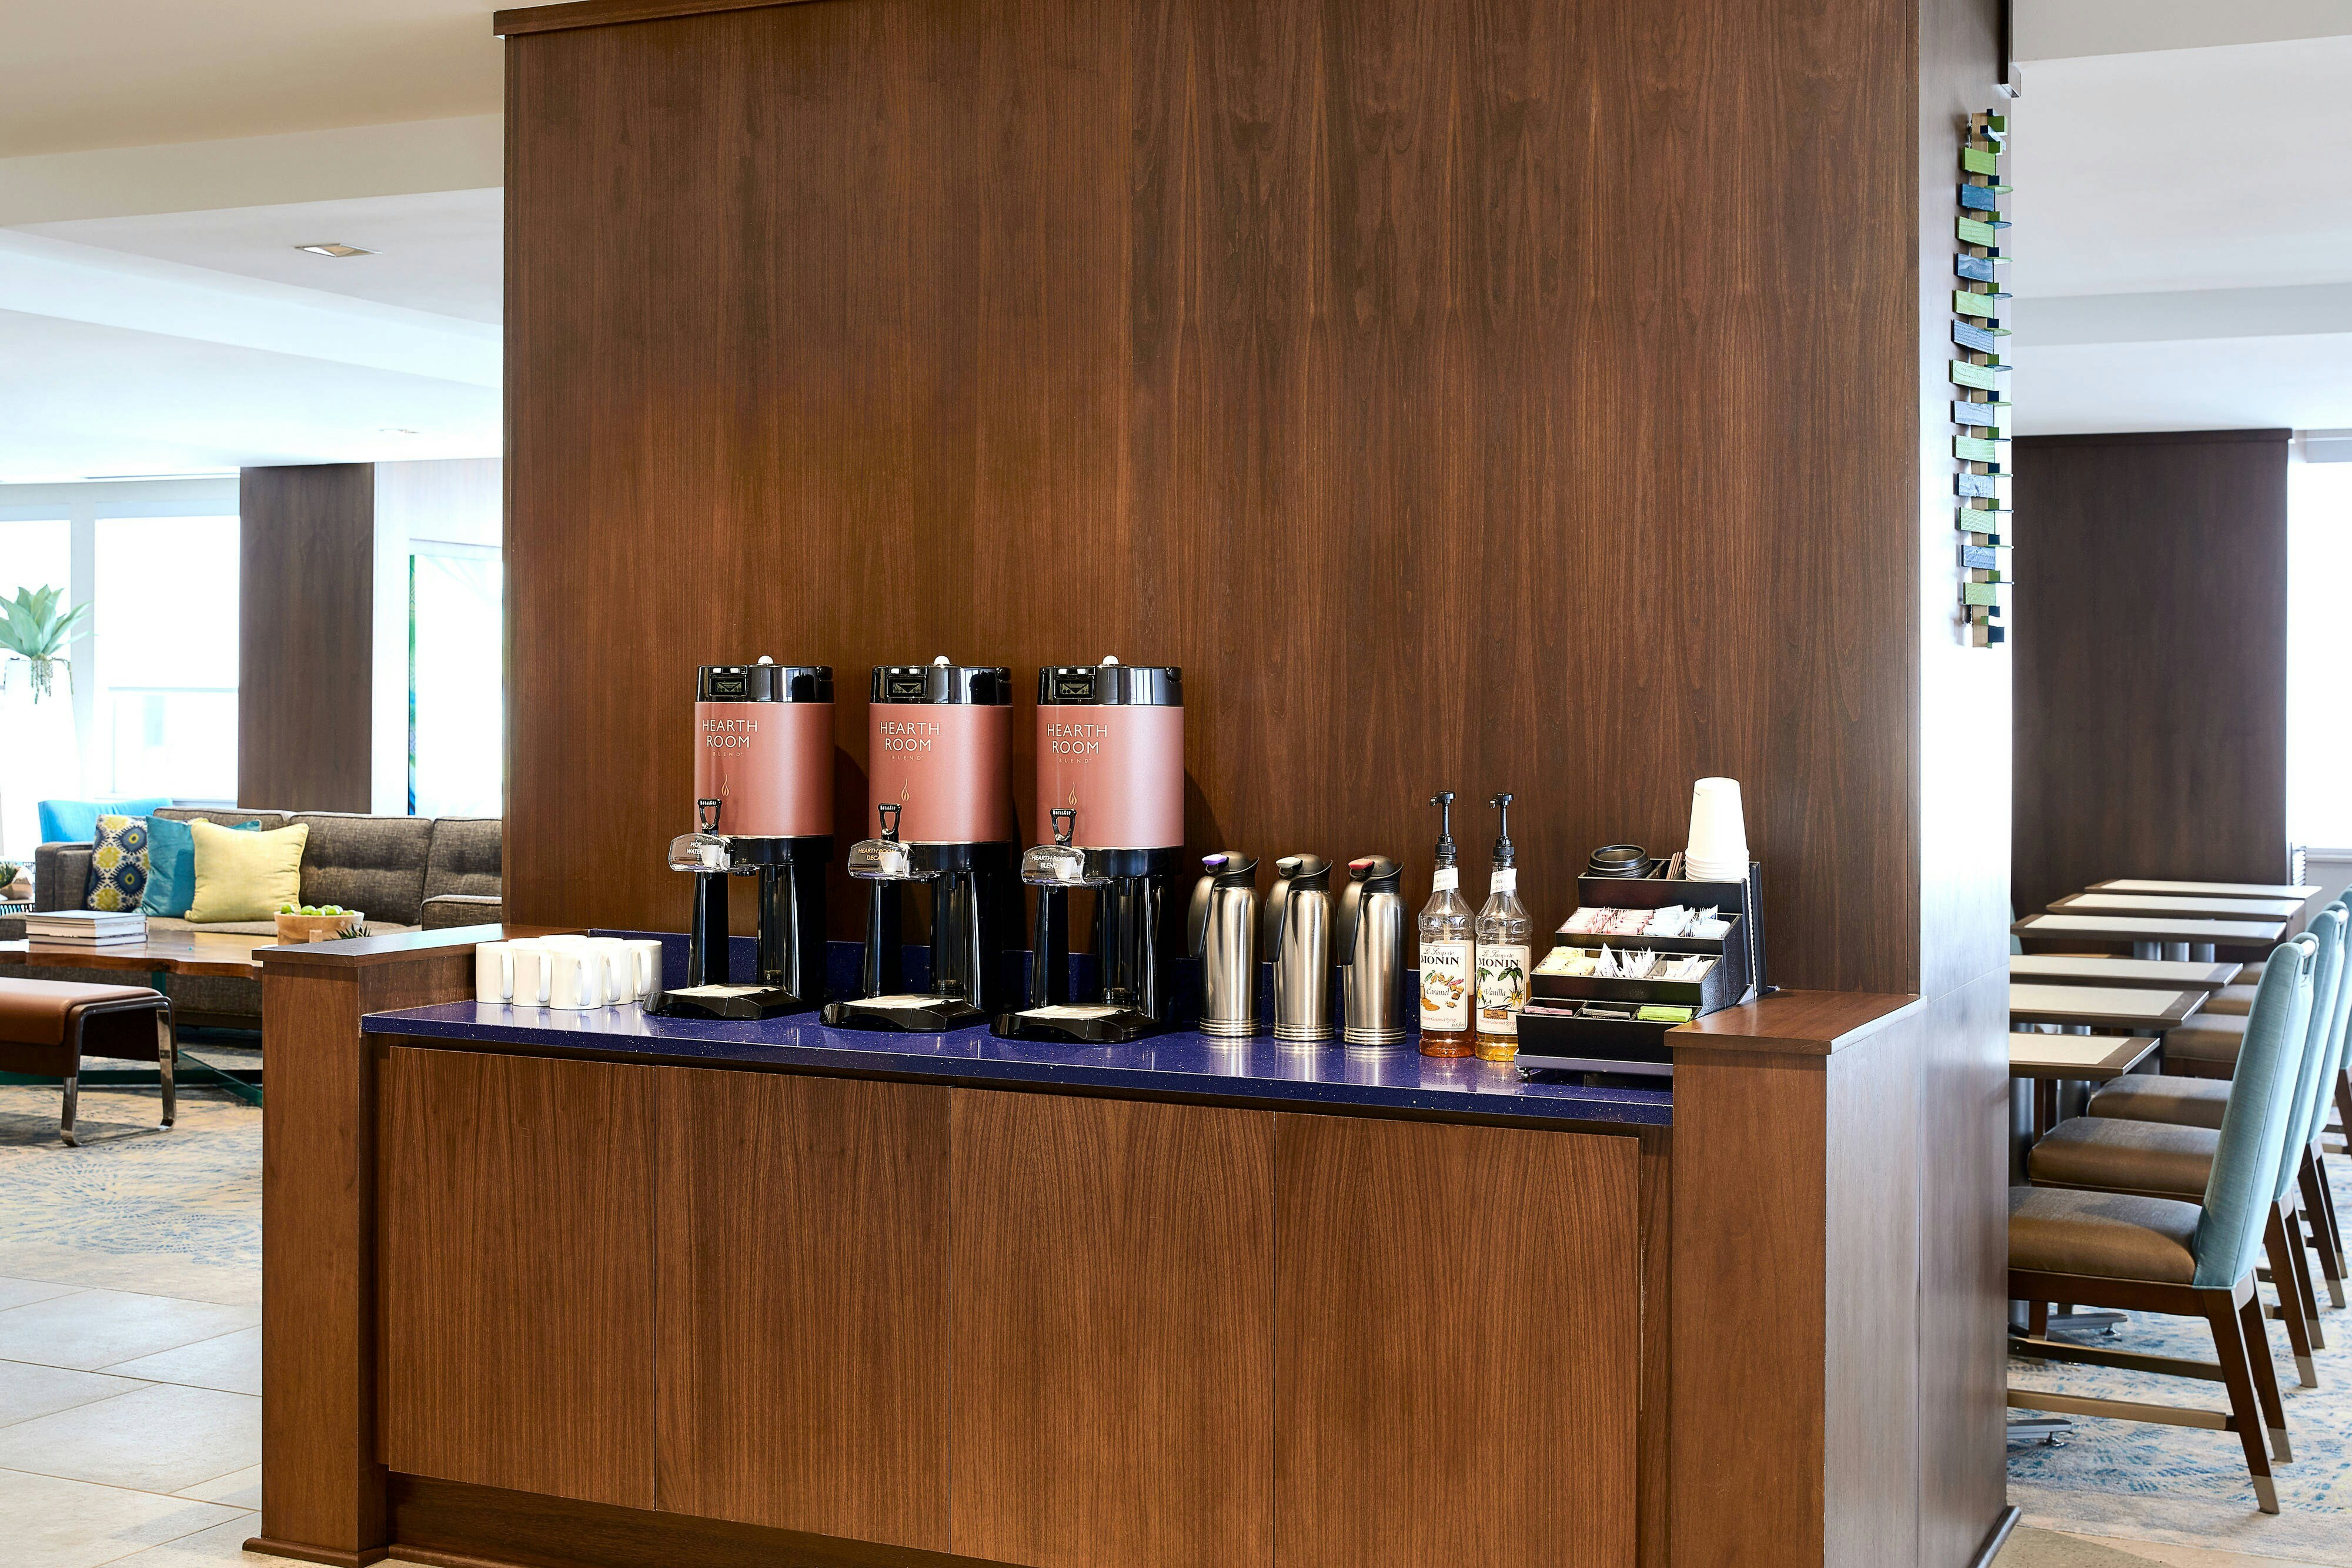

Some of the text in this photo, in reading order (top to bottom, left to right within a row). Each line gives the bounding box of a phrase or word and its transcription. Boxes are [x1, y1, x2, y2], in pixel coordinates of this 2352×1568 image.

[703, 719, 757, 732] HEARTH
[880, 722, 939, 735] HEARTH
[1047, 724, 1107, 737] HEARTH
[707, 735, 750, 748] ROOM
[885, 738, 931, 751] ROOM
[1053, 740, 1099, 754] ROOM
[1421, 955, 1459, 965] MONIN
[1478, 958, 1519, 967] MONIN
[1426, 986, 1449, 996] Caramel
[1484, 988, 1506, 997] Vanilla
